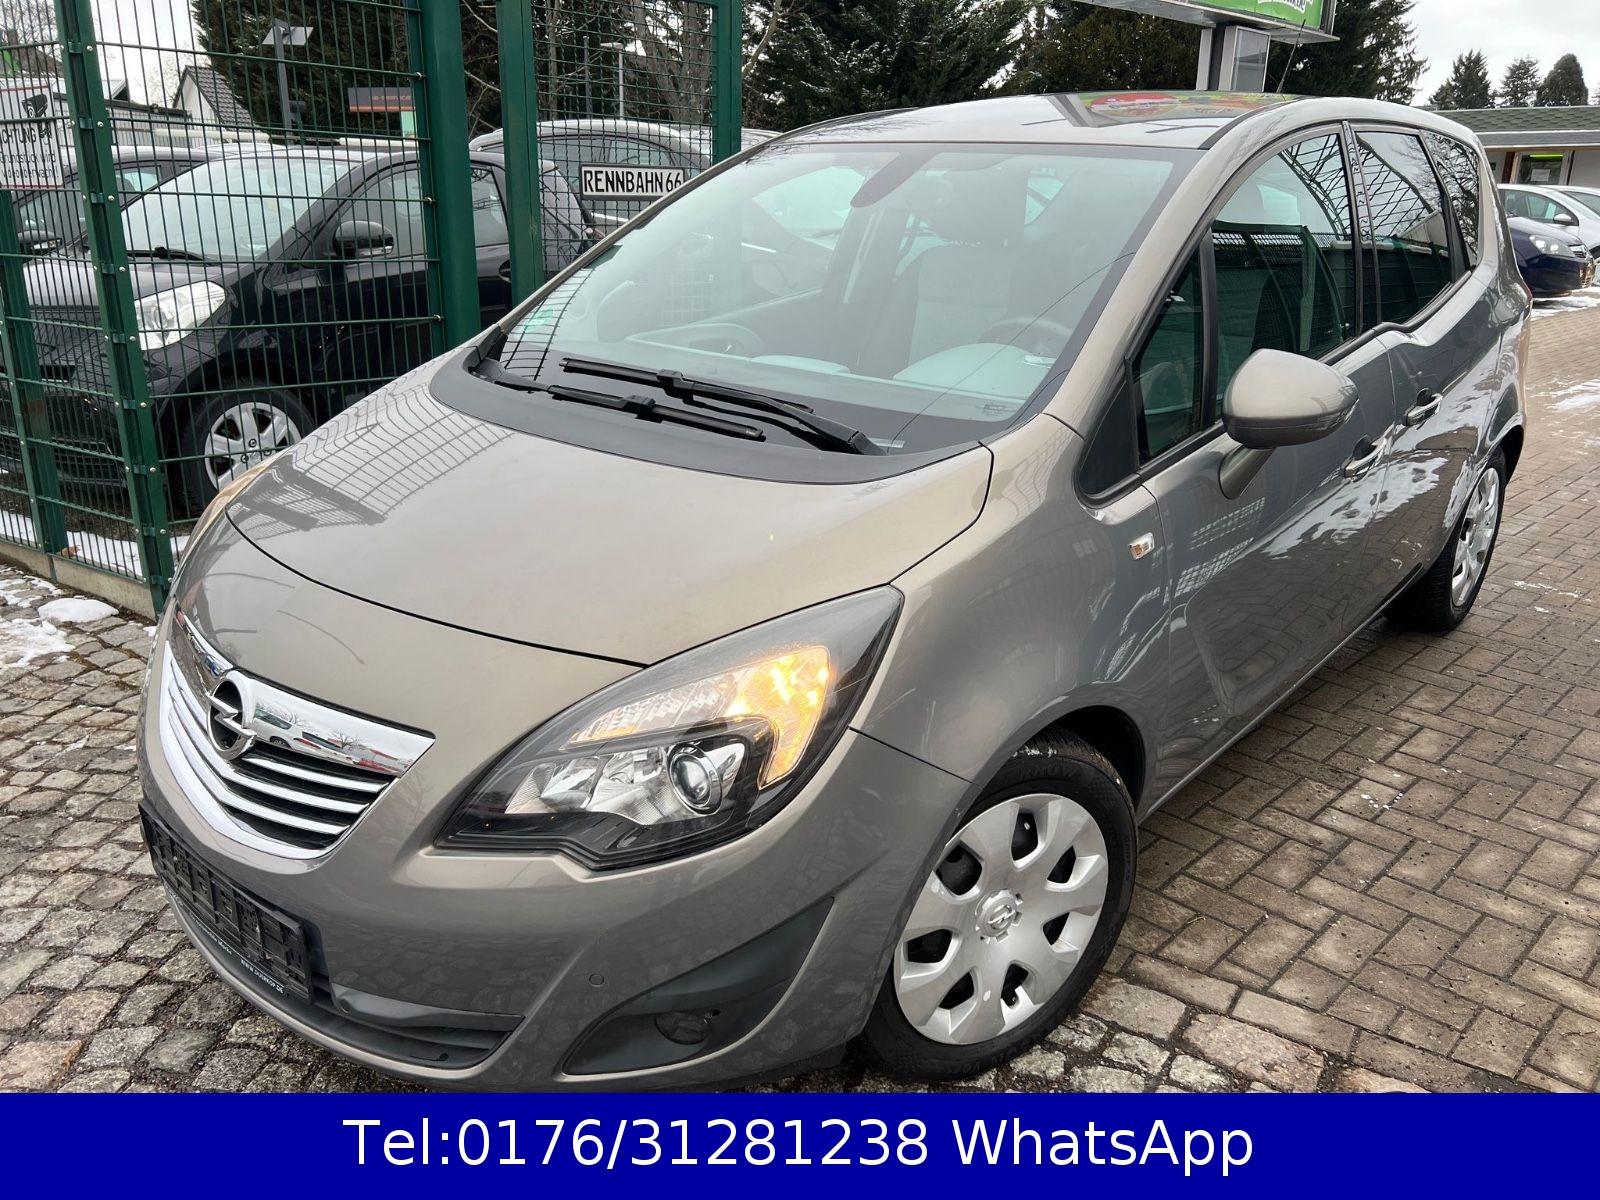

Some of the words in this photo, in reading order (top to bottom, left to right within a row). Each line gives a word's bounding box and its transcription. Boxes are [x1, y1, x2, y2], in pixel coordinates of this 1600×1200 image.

[0, 127, 37, 144] CHTUNG
[583, 170, 663, 193] RENNBAHN
[665, 172, 681, 192] 66
